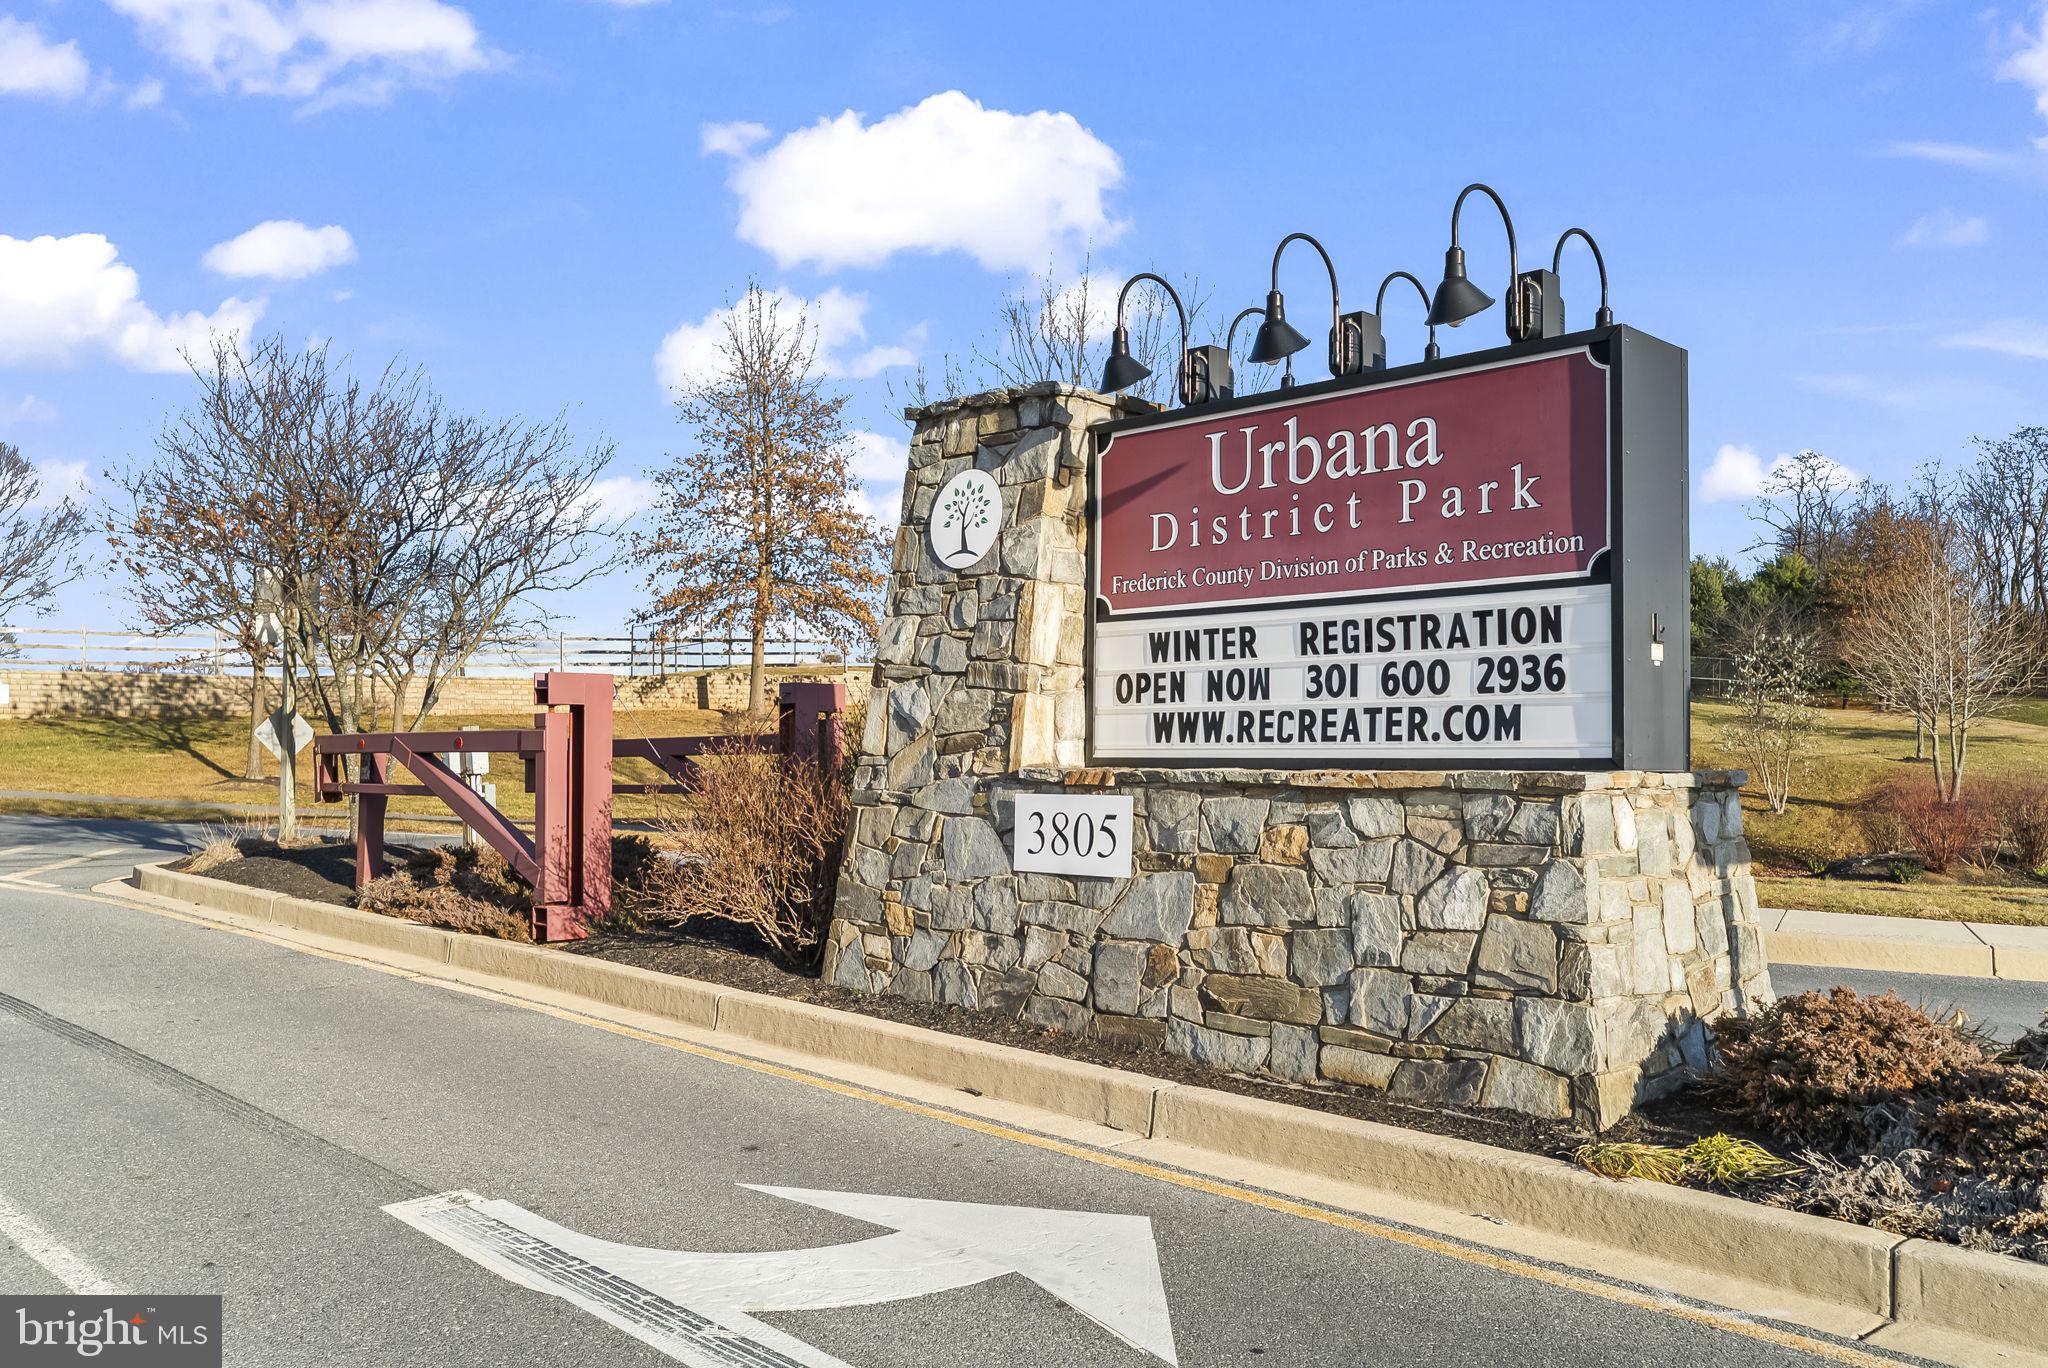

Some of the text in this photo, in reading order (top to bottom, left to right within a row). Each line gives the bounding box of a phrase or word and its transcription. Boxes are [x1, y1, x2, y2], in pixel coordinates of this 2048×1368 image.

[1204, 415, 1444, 496] Urbana
[1149, 463, 1542, 553] District Park
[1112, 531, 1585, 595] Frederick County Division of Parks & Recreation
[1149, 605, 1564, 663] WINTER REGISTRATION
[1115, 670, 1186, 704] OPEN
[1207, 667, 1271, 702] NOW
[1380, 659, 1451, 696] 600
[1476, 653, 1567, 695] 2936
[1153, 703, 1522, 745] WWW.RECREATER.COM
[1027, 811, 1118, 858] 3805
